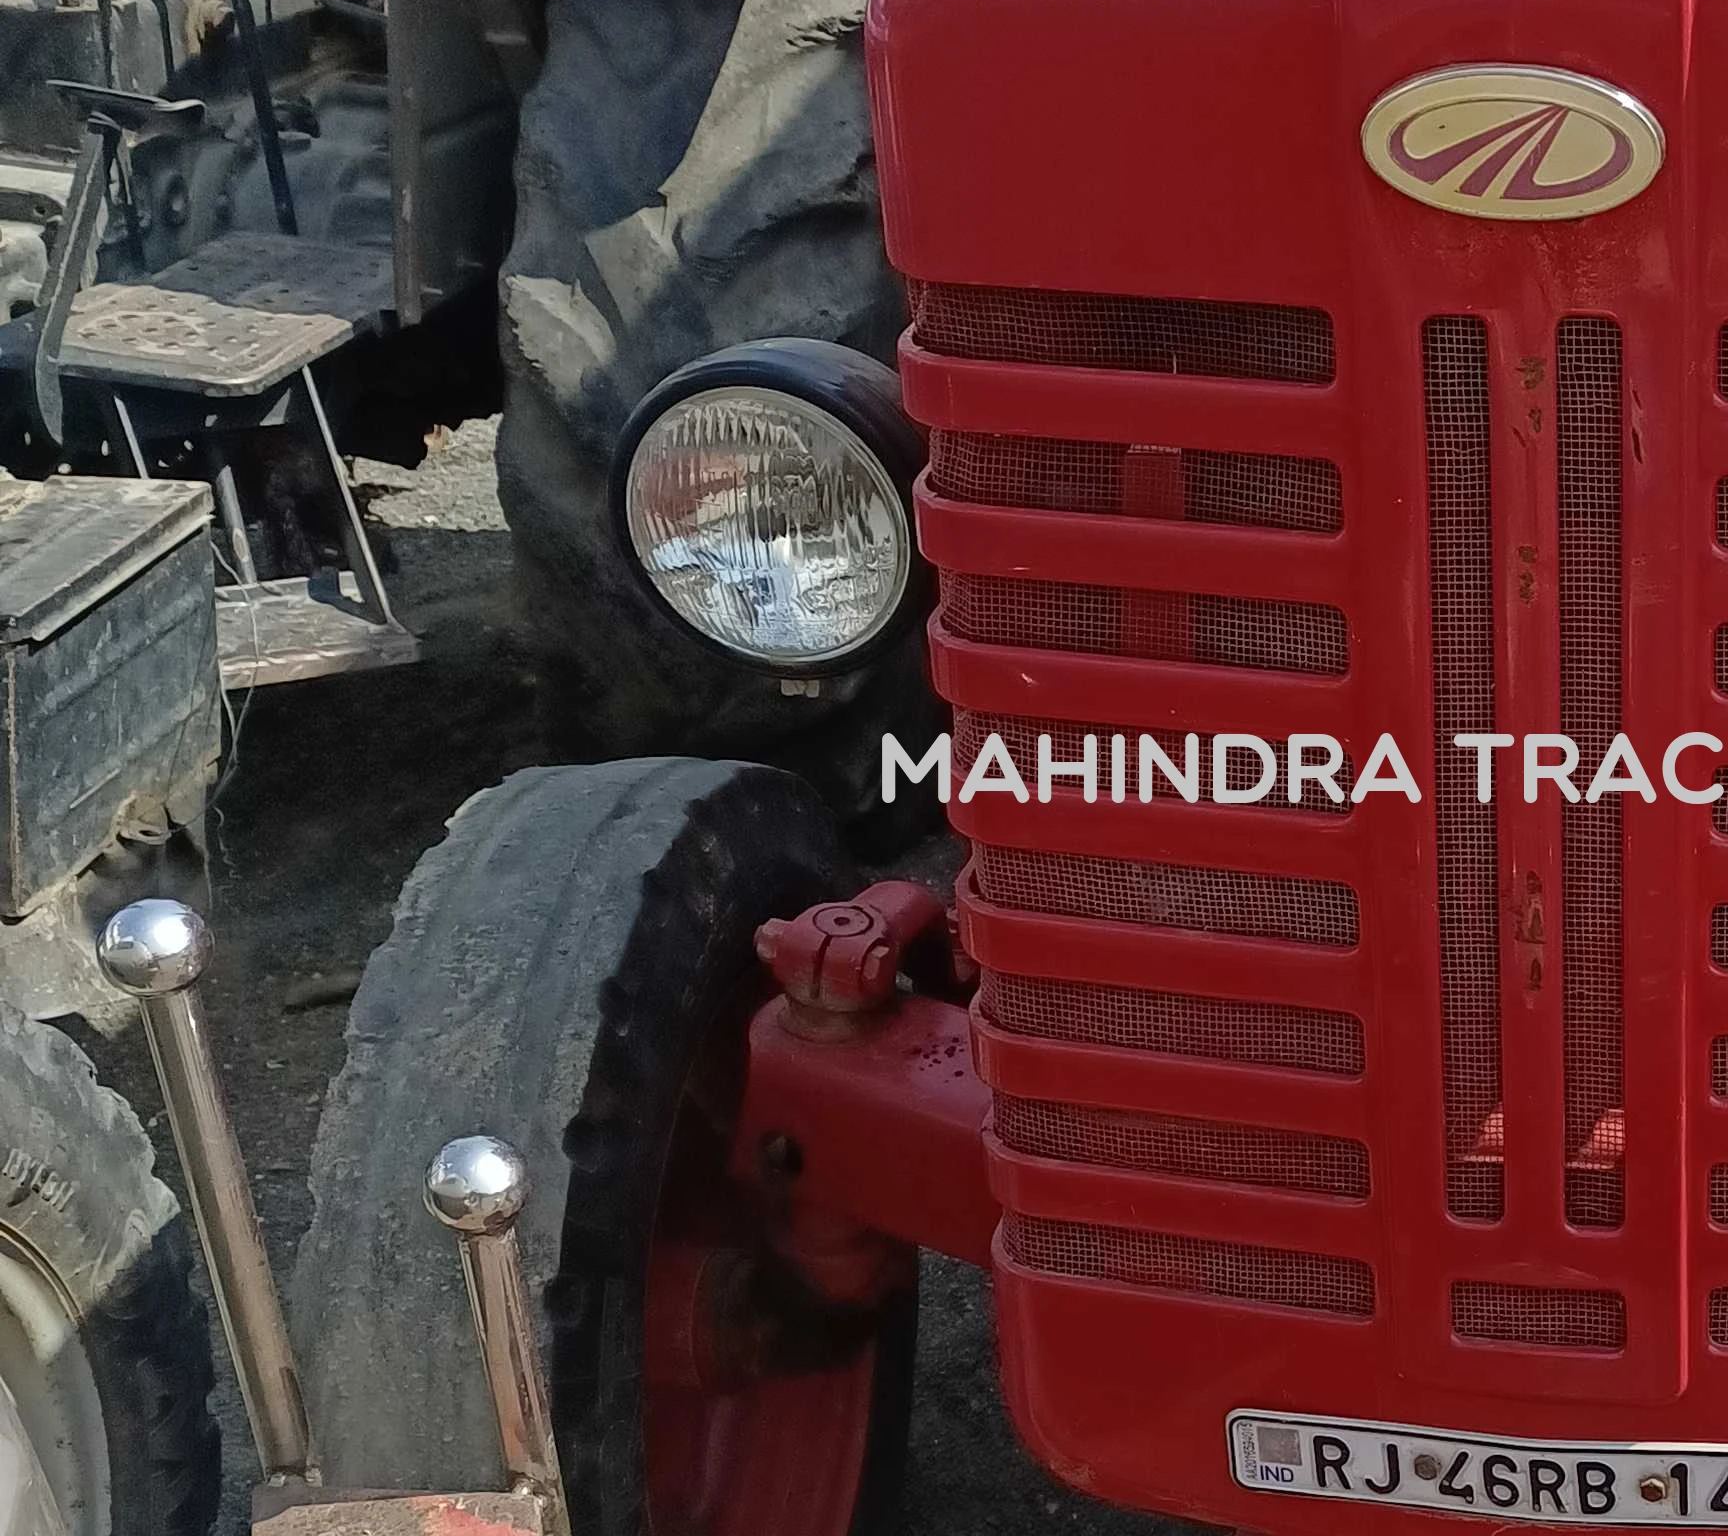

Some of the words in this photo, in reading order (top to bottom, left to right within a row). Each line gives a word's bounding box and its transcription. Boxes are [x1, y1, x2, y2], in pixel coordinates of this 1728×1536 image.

[1260, 1465, 1294, 1483] IND
[1313, 1435, 1401, 1495] RJ
[1438, 1451, 1616, 1515] 46RB
